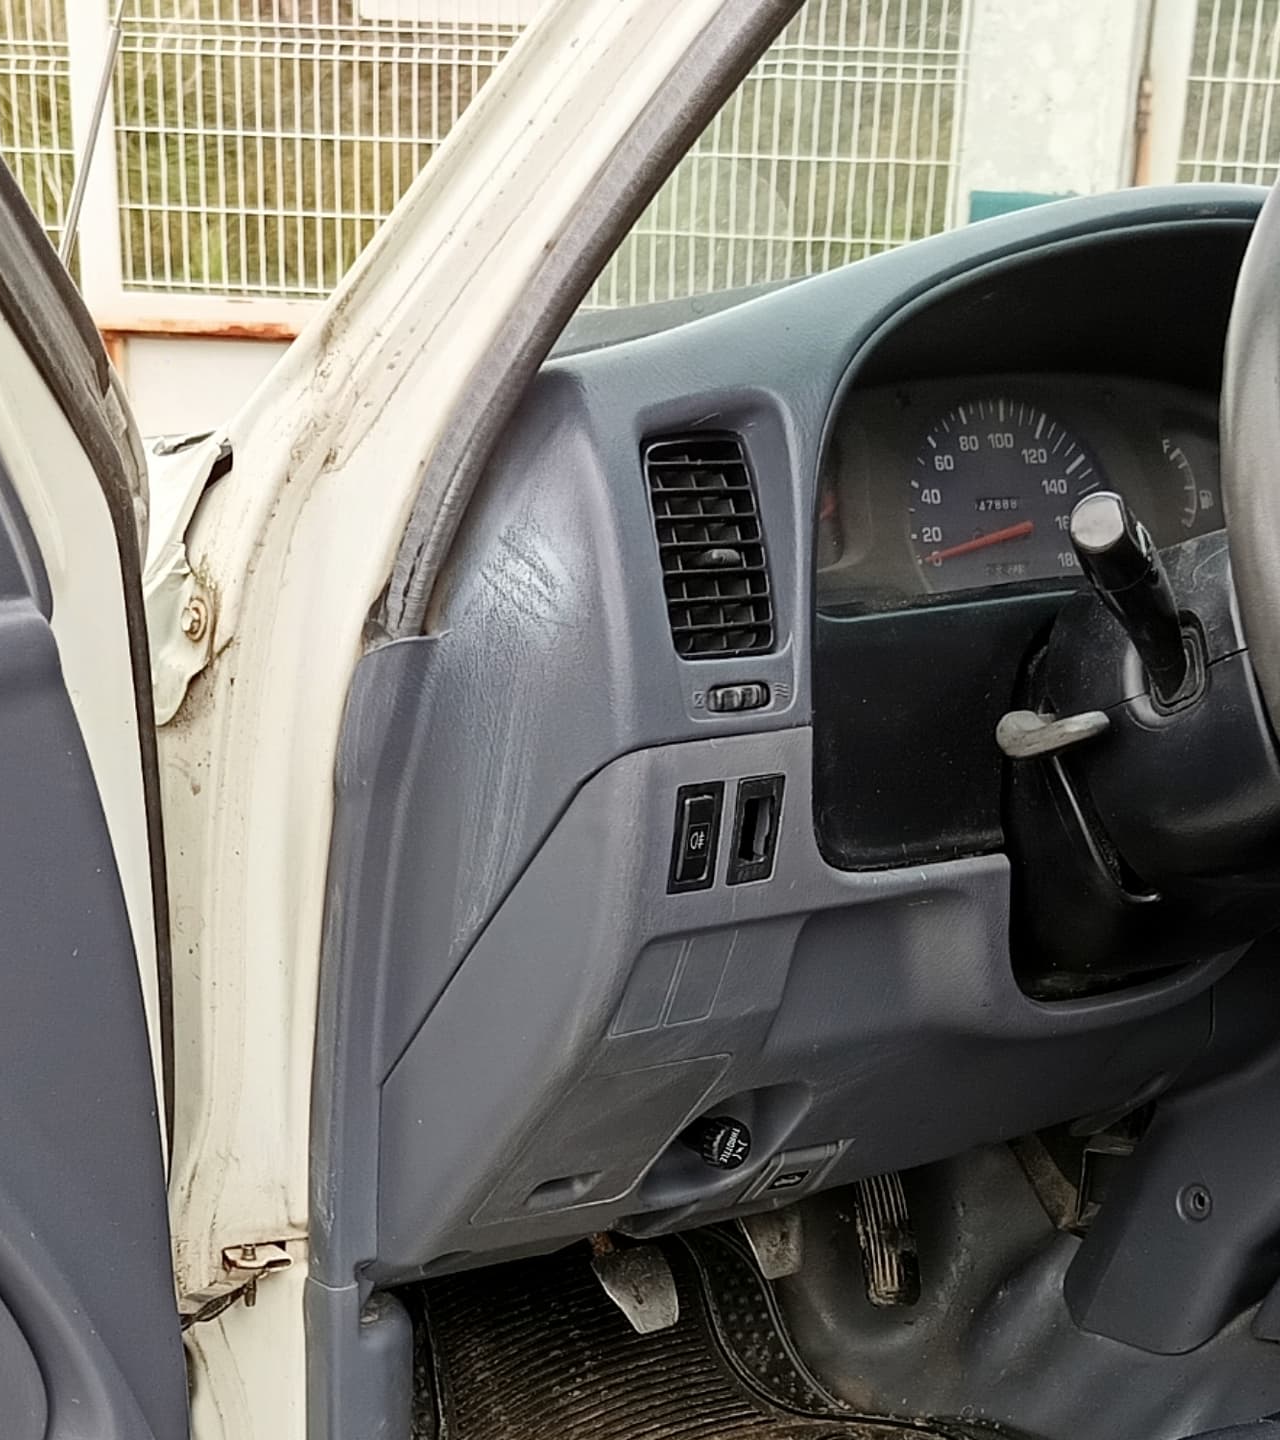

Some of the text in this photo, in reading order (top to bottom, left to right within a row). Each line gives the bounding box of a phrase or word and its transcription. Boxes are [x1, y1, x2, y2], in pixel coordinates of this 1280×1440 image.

[959, 435, 979, 451] 80
[987, 433, 1014, 449] 100
[934, 454, 954, 471] 60
[1021, 448, 1047, 464] 120
[1041, 479, 1067, 495] 140
[921, 489, 941, 504] 40
[1054, 515, 1070, 530] 16
[922, 526, 942, 542] 20
